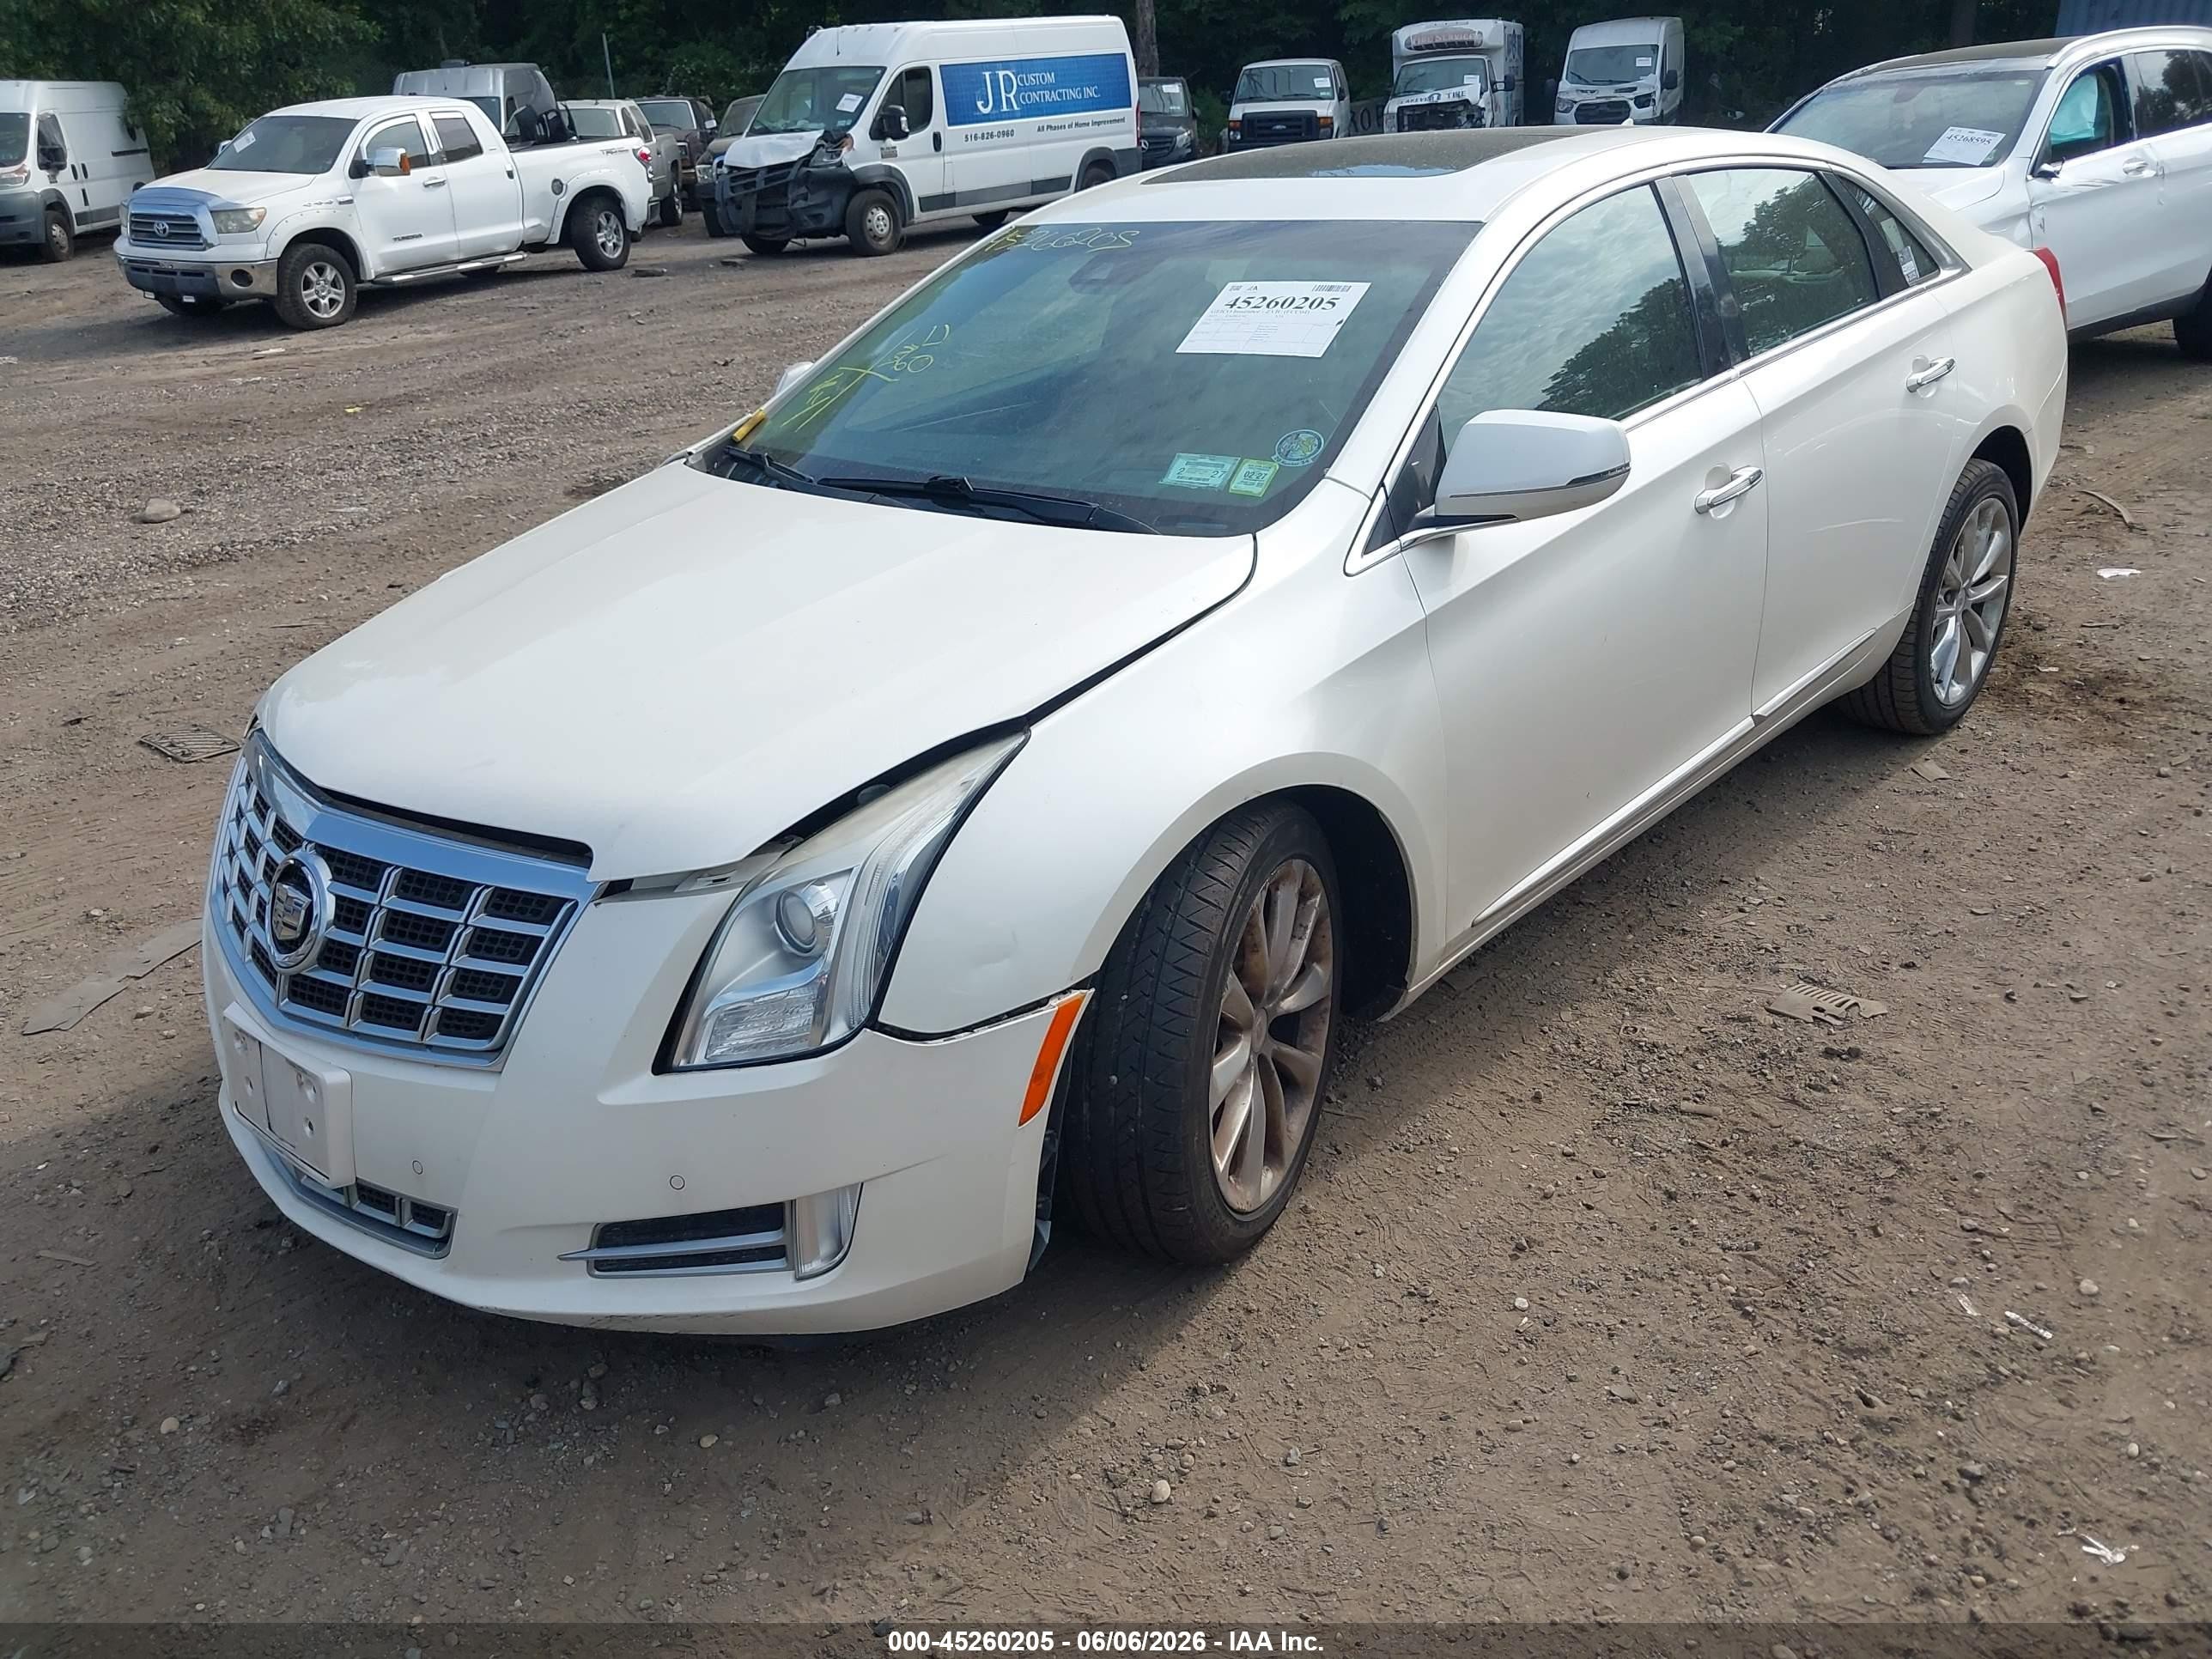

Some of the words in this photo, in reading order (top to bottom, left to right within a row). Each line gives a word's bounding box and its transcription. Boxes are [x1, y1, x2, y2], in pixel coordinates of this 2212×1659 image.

[1017, 72, 1055, 86] CUSTOM
[1019, 88, 1083, 105] CONTRACTING
[1084, 87, 1101, 100] INC.
[1448, 90, 1465, 99] TIRE
[1046, 123, 1066, 131] Phases
[1091, 117, 1126, 128] Improvement
[964, 130, 1015, 143] 516-826-0960
[1947, 132, 1993, 145] 45268595
[1224, 295, 1340, 310] 45260205
[1211, 470, 1227, 478] 27
